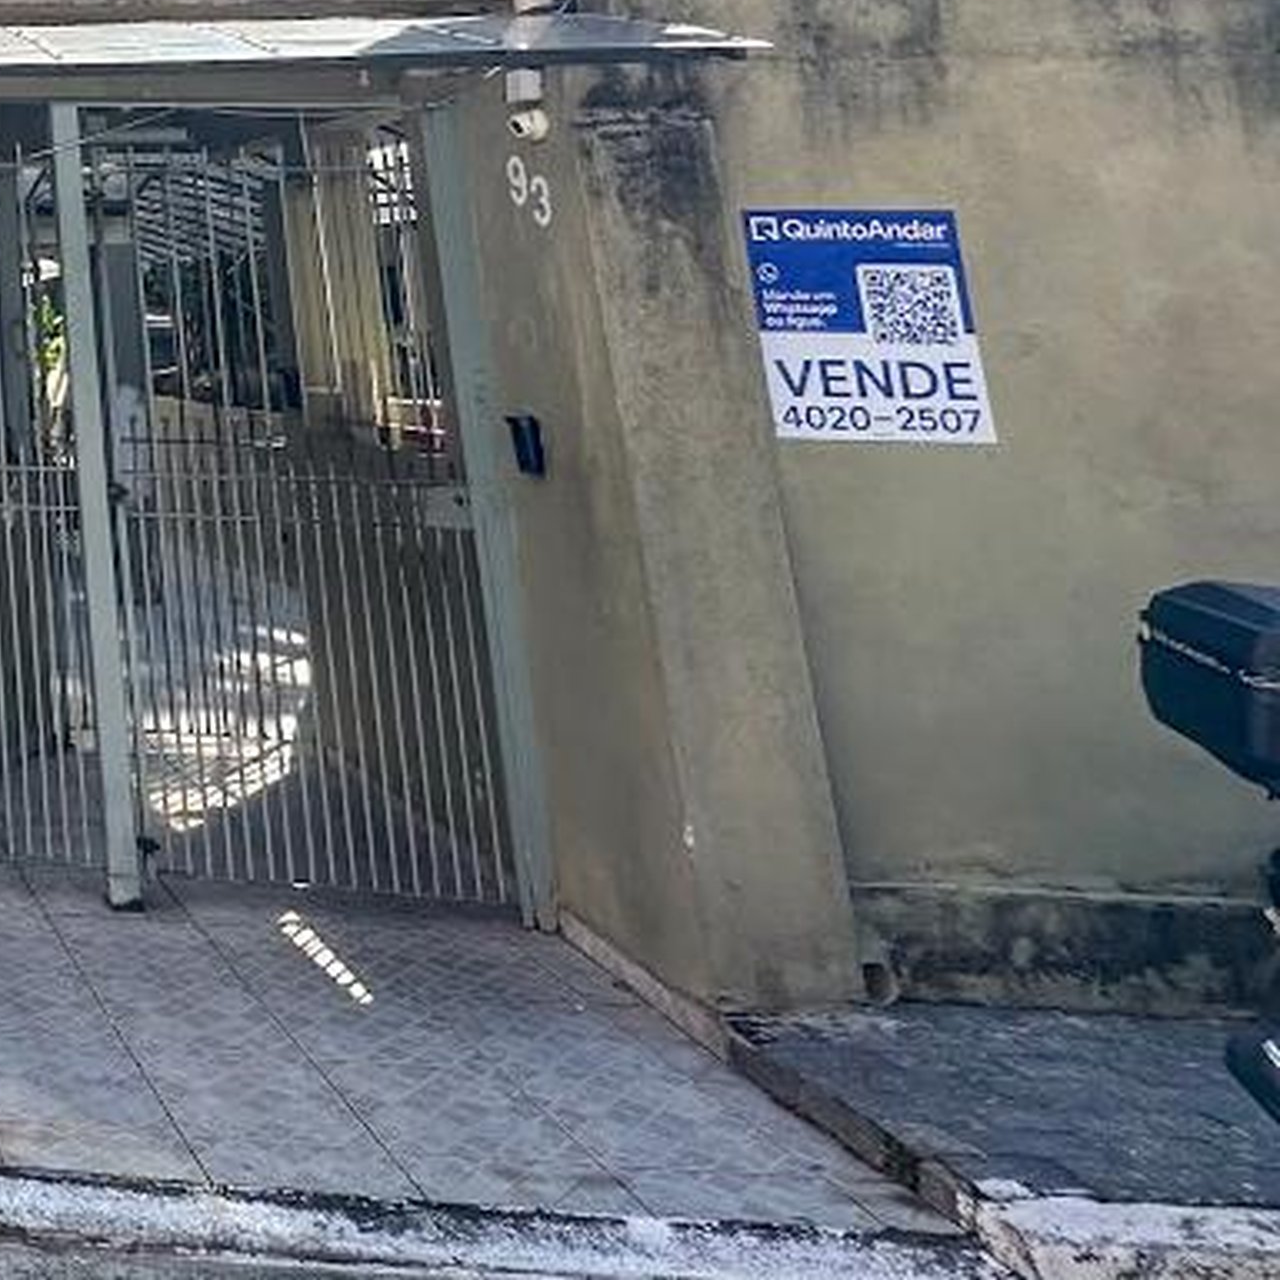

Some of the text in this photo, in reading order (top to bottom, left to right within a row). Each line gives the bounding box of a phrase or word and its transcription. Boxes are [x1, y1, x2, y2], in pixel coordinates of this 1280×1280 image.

[506, 155, 552, 227] 93
[782, 218, 949, 241] QuintoAndar
[774, 359, 978, 402] VENDE
[782, 405, 981, 434] 4020-2507
